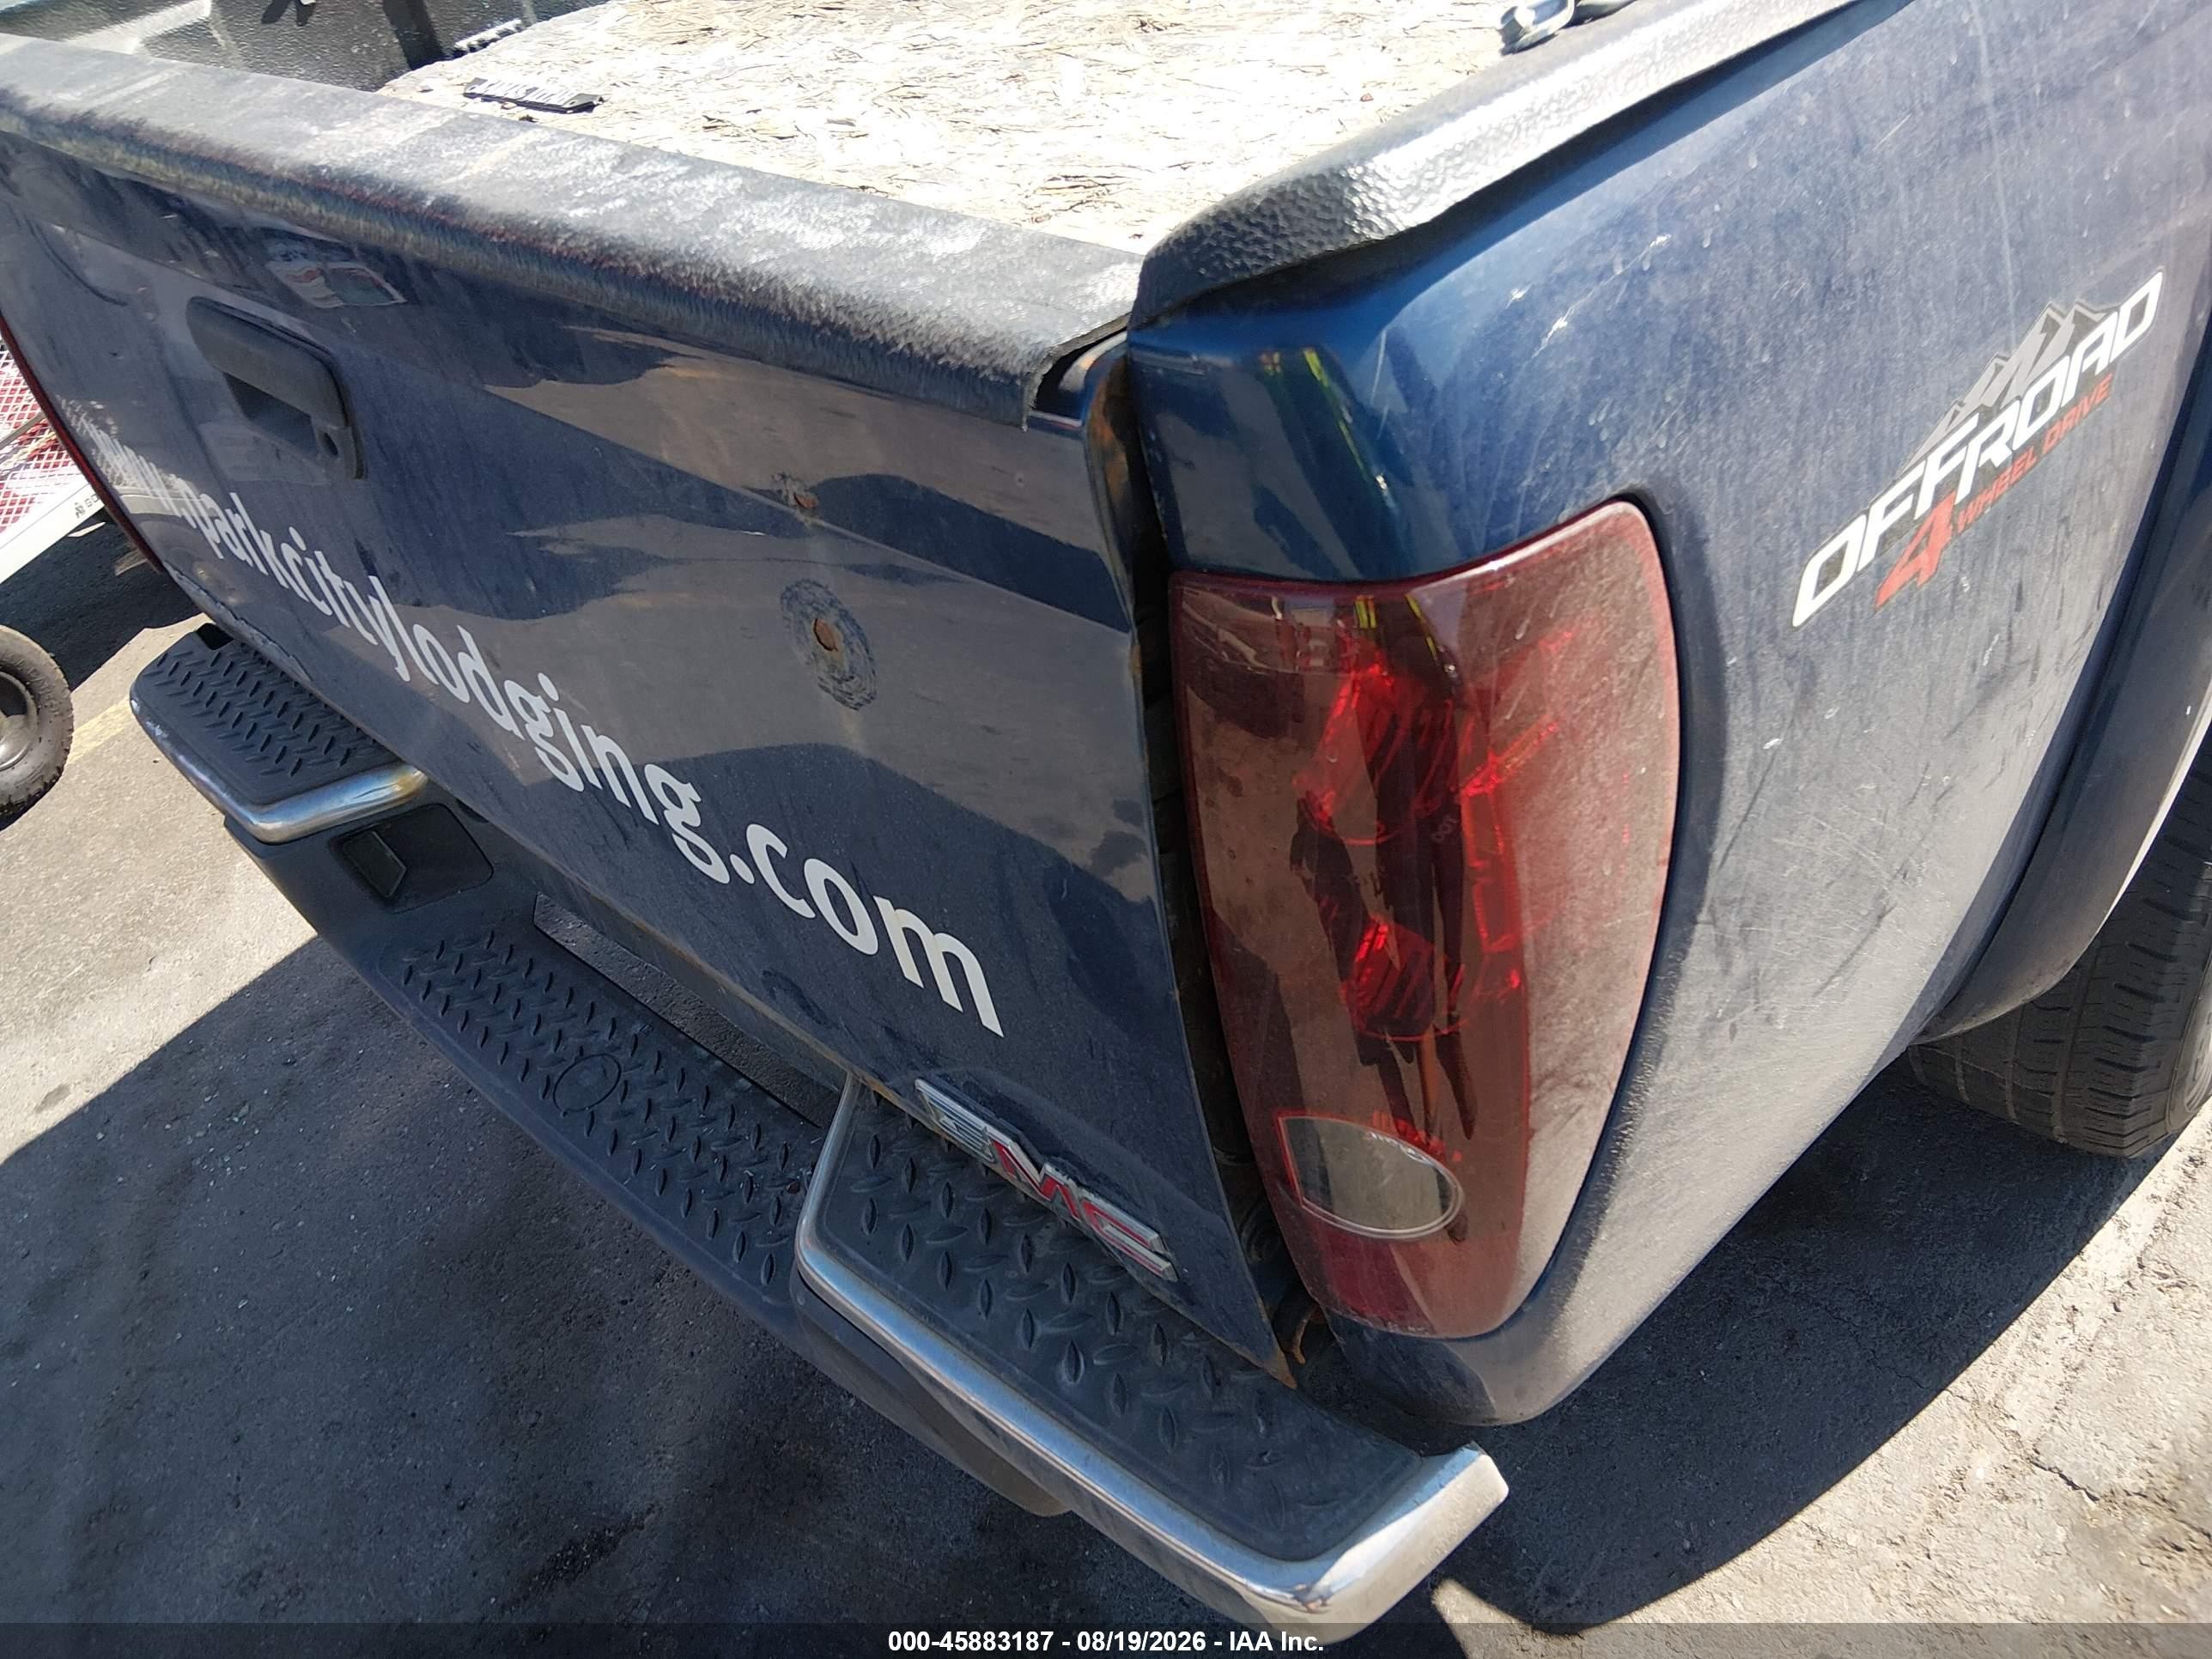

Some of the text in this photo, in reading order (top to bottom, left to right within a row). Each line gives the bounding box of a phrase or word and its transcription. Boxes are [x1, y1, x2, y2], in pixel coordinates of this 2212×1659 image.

[1791, 270, 2164, 629] OFFROAD
[1875, 373, 2113, 611] 4 WHEEL DRIVE
